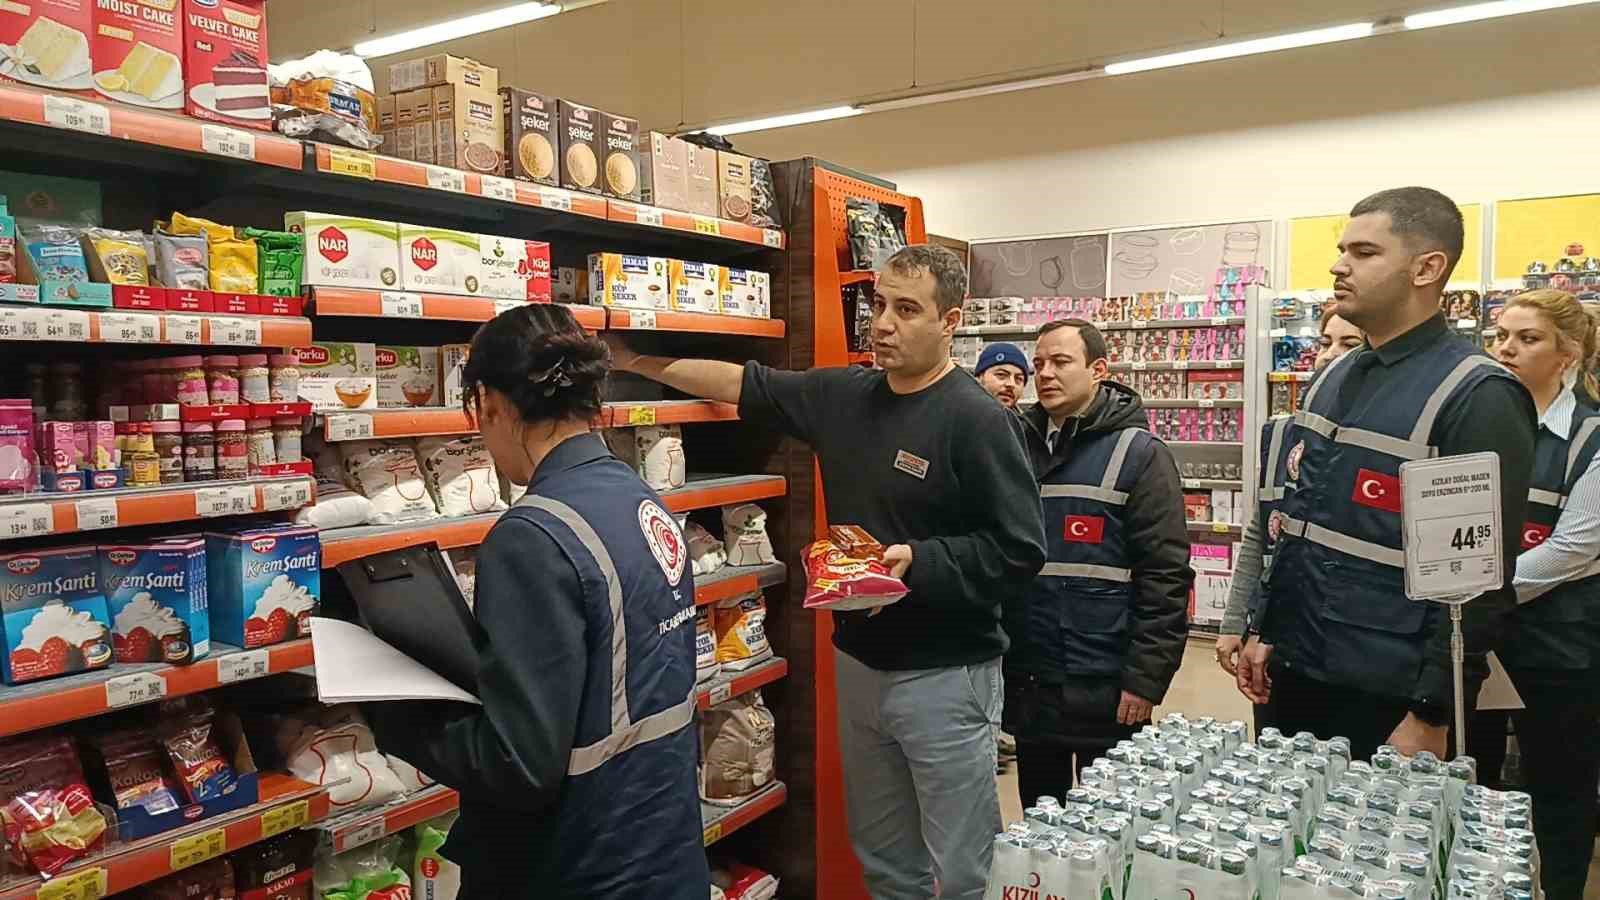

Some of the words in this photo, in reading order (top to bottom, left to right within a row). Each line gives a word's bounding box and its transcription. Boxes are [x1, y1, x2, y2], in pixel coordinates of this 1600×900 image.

[97, 0, 139, 16] MOIST
[143, 6, 175, 25] CAKE
[189, 12, 229, 34] VELVET
[231, 24, 259, 43] CAKE
[521, 116, 550, 132] şeker
[568, 126, 594, 142] şeker
[607, 136, 632, 151] şeker
[320, 237, 348, 253] NAR
[412, 247, 437, 262] NAR
[247, 559, 283, 577] Krem
[6, 580, 53, 601] Krem
[105, 574, 145, 593] Krem
[1003, 886, 1066, 900] KIZIL
